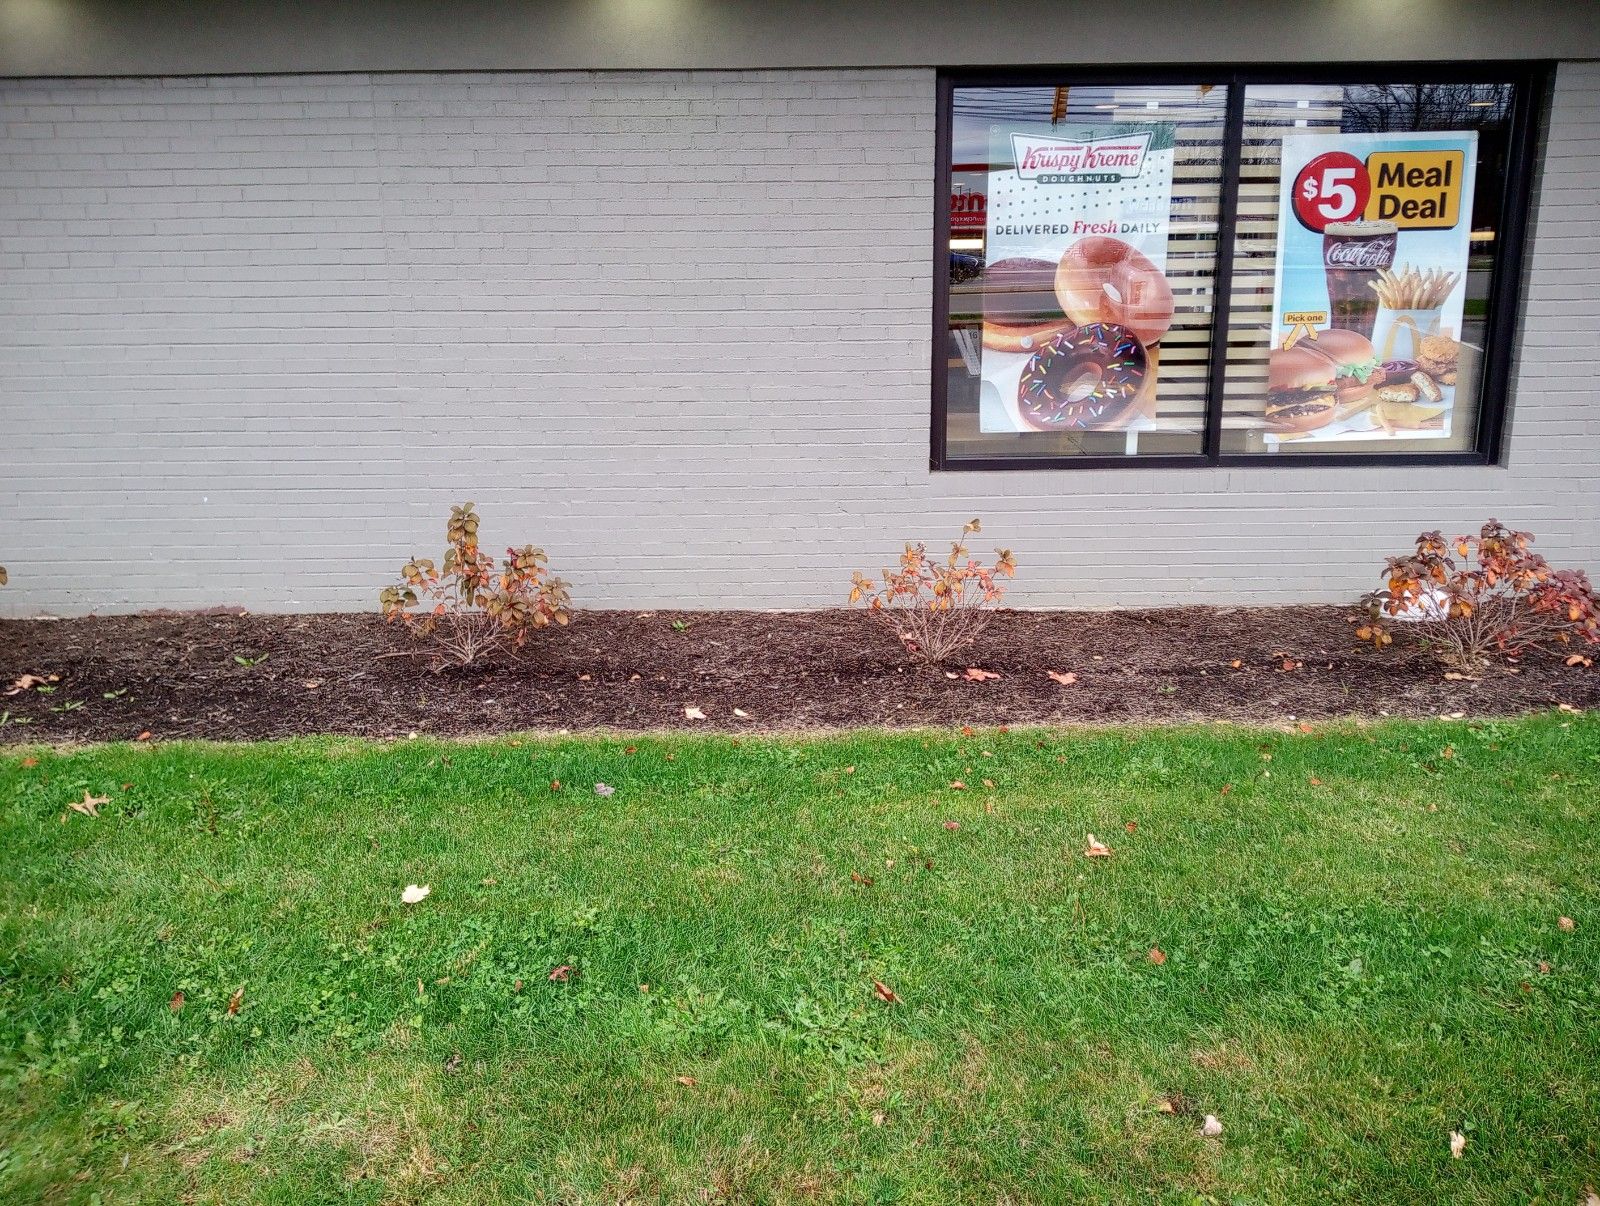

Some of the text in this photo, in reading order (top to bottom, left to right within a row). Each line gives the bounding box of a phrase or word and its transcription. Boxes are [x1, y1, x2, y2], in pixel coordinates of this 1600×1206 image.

[1022, 145, 1142, 172] Krispy Kreme
[1042, 175, 1117, 183] DOUGHNUTS
[1302, 160, 1453, 220] $5 Meal
[1378, 192, 1448, 220] Deal
[995, 219, 1161, 236] DELIVERED Fresh DAILY
[1287, 314, 1324, 323] Pick one
